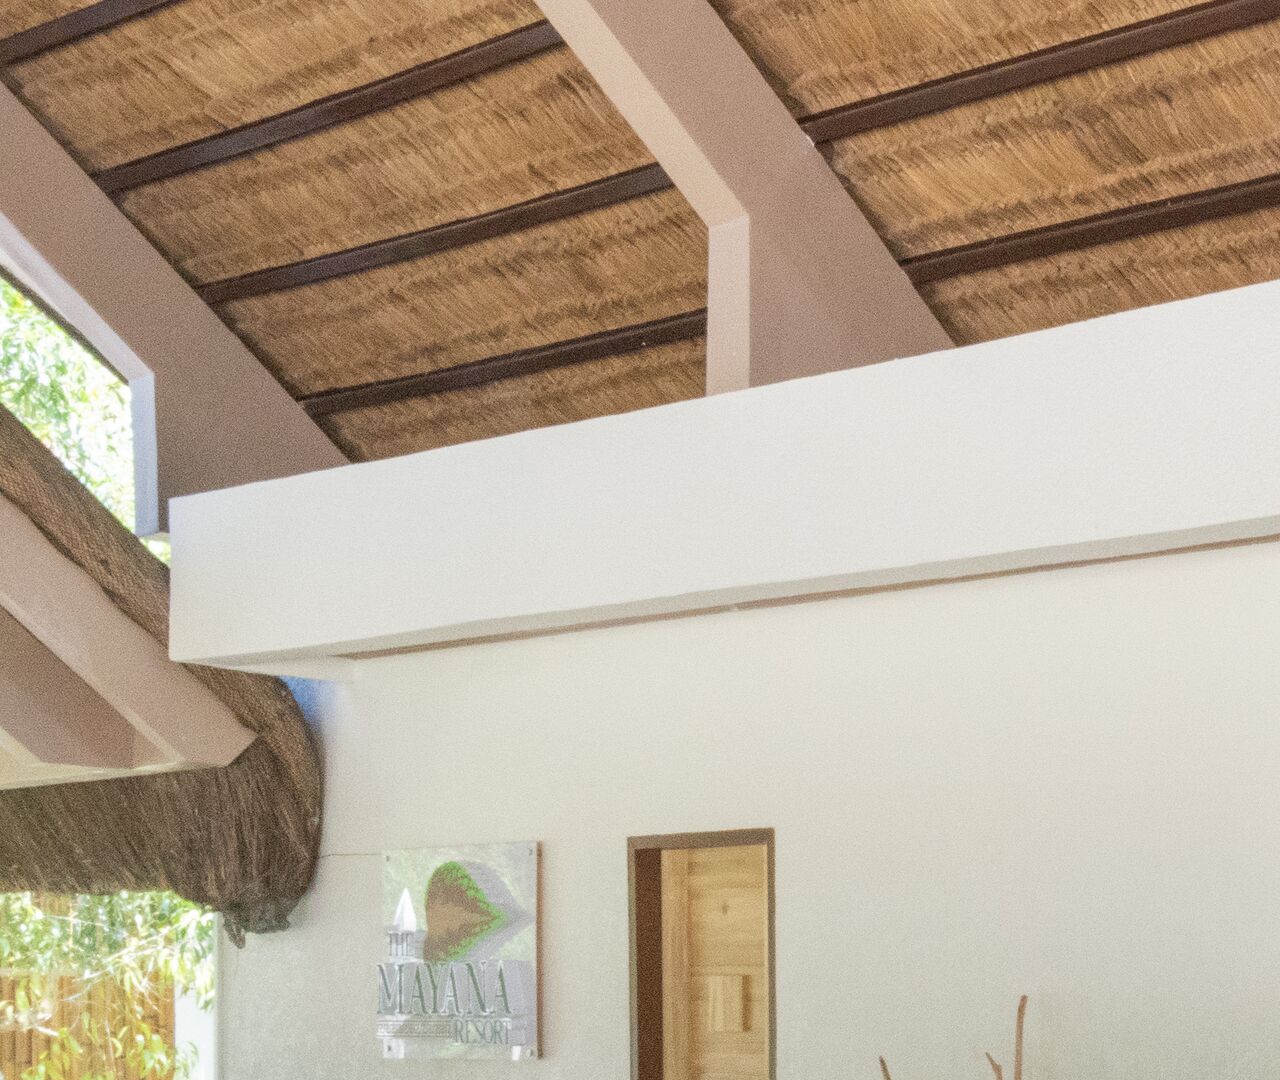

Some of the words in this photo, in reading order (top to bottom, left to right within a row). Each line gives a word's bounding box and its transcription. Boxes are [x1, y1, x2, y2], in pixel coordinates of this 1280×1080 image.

[387, 932, 414, 957] THE
[377, 960, 513, 1015] MAYANA
[454, 1018, 512, 1045] RESORT
